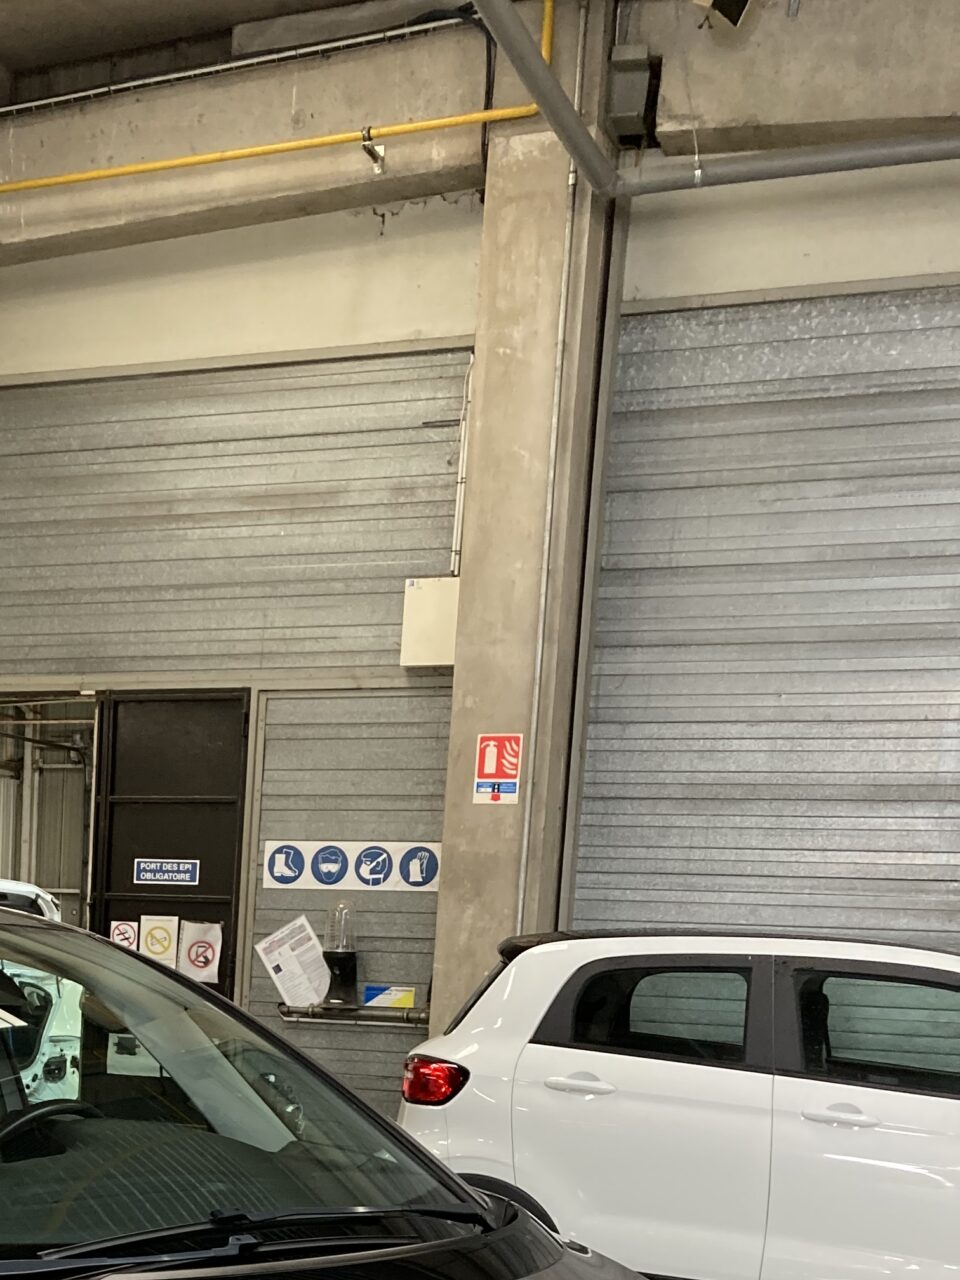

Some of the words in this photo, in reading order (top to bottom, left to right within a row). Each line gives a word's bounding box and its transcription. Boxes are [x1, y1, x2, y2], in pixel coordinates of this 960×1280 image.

[140, 862, 161, 870] PORT
[162, 863, 178, 871] DES
[179, 863, 192, 871] EPI
[140, 872, 191, 881] OBLIGATOIRE
